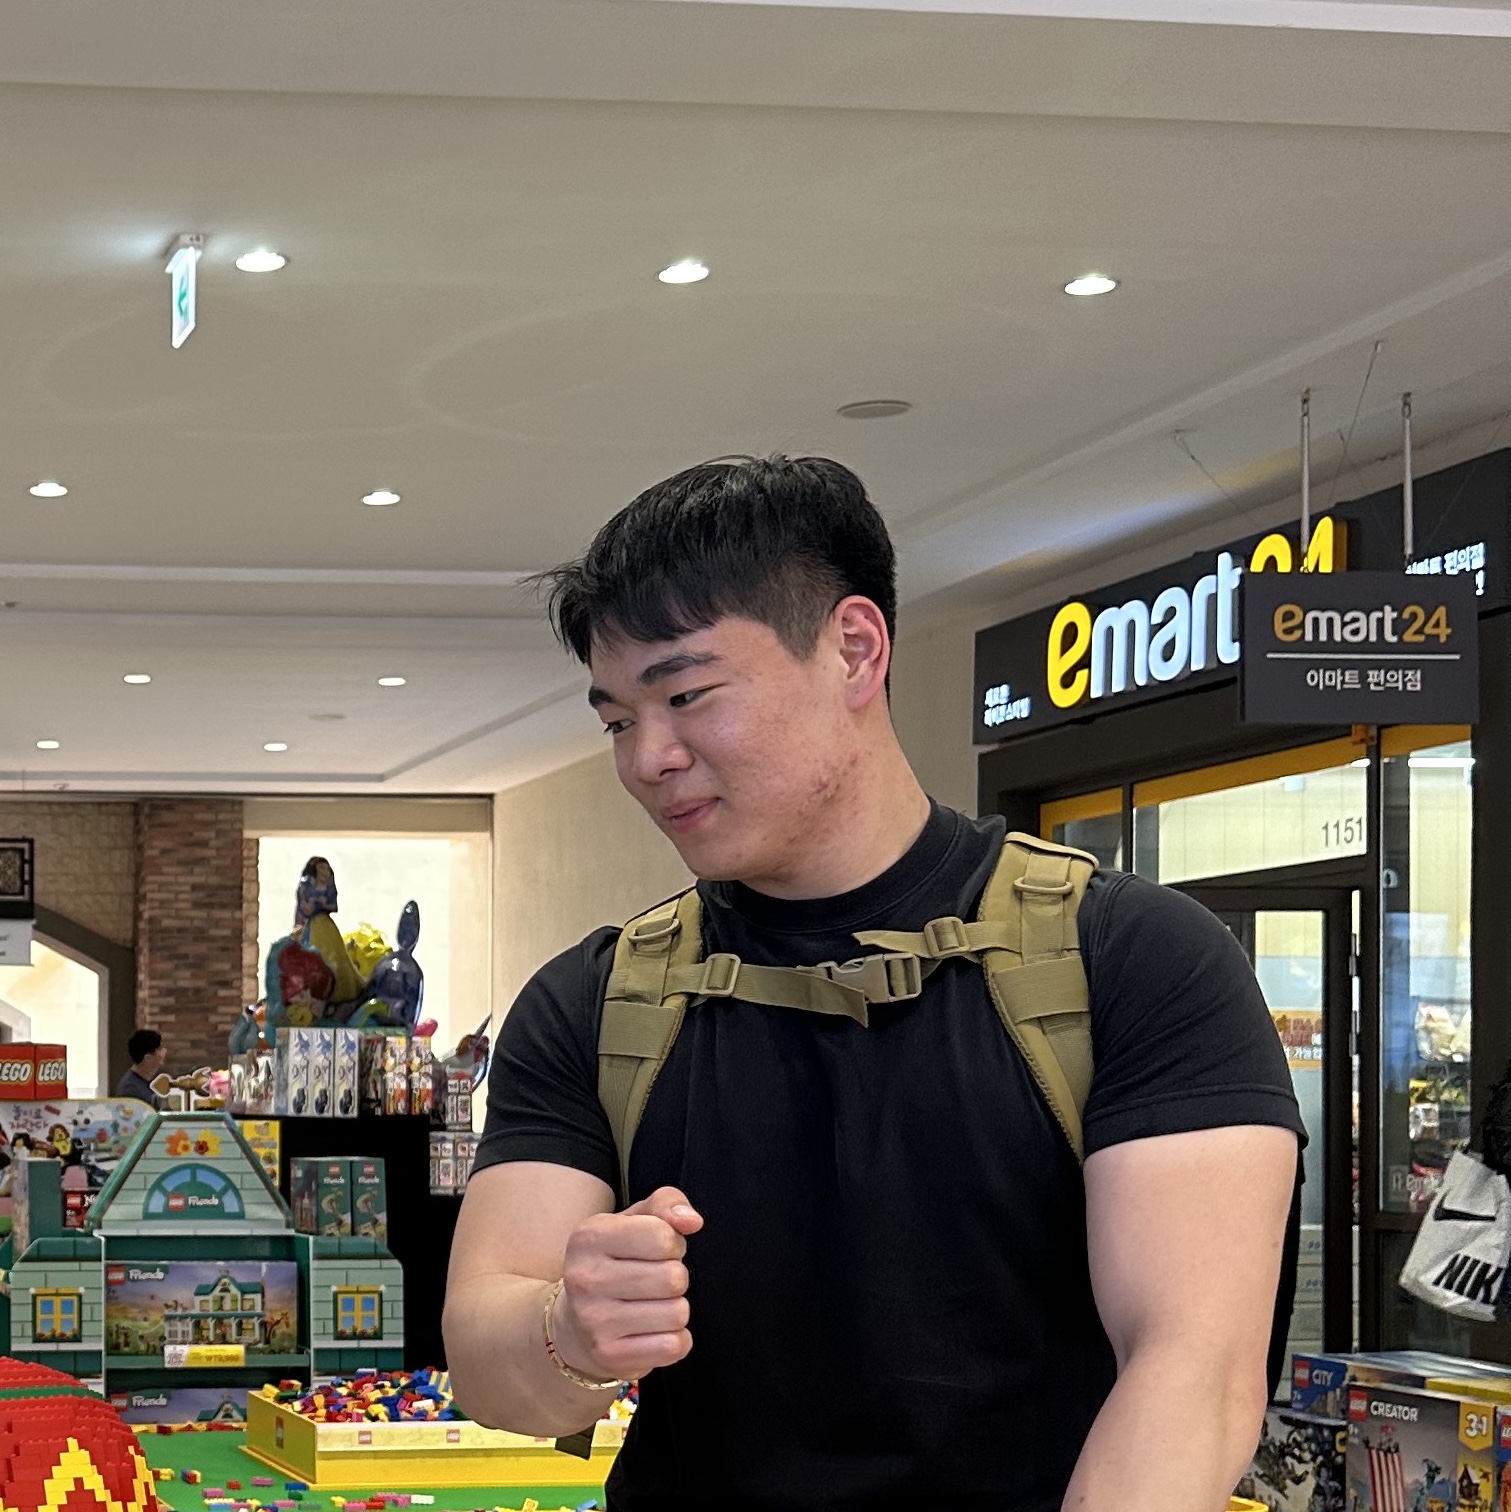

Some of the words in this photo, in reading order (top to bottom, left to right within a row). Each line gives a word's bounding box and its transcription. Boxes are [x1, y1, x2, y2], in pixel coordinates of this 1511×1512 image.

[1273, 603, 1453, 644] emart24
[1306, 668, 1362, 692] 이마트
[1366, 668, 1423, 692] 편의점
[1321, 816, 1364, 848] 1151
[37, 1061, 66, 1082] LEGO
[1312, 1368, 1334, 1387] CITY
[1370, 1401, 1419, 1422] CREATOR
